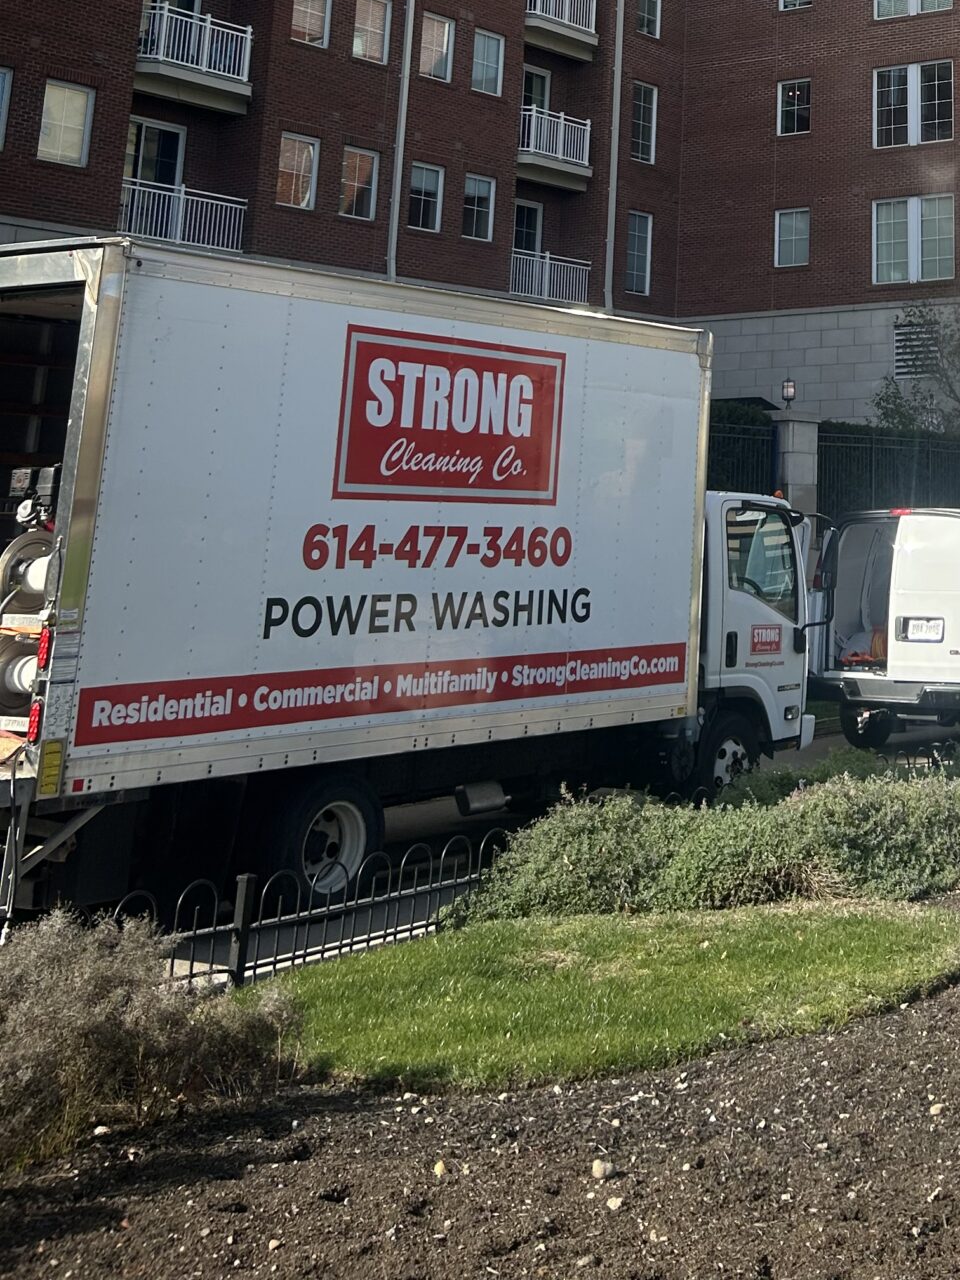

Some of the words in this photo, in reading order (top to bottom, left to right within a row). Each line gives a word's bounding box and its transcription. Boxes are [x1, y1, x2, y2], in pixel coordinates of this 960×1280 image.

[365, 357, 534, 438] STRONG
[379, 437, 484, 484] Cleaning
[492, 445, 527, 481] Co.
[302, 523, 572, 570] 614-477-3460
[263, 593, 418, 639] POWER
[431, 587, 591, 631] WASHING
[753, 628, 780, 643] STRONG
[91, 688, 233, 728] Residential
[253, 675, 379, 711] Commercial
[396, 667, 497, 697] Multifamily
[511, 655, 679, 687] StrongCleaningCo.com
